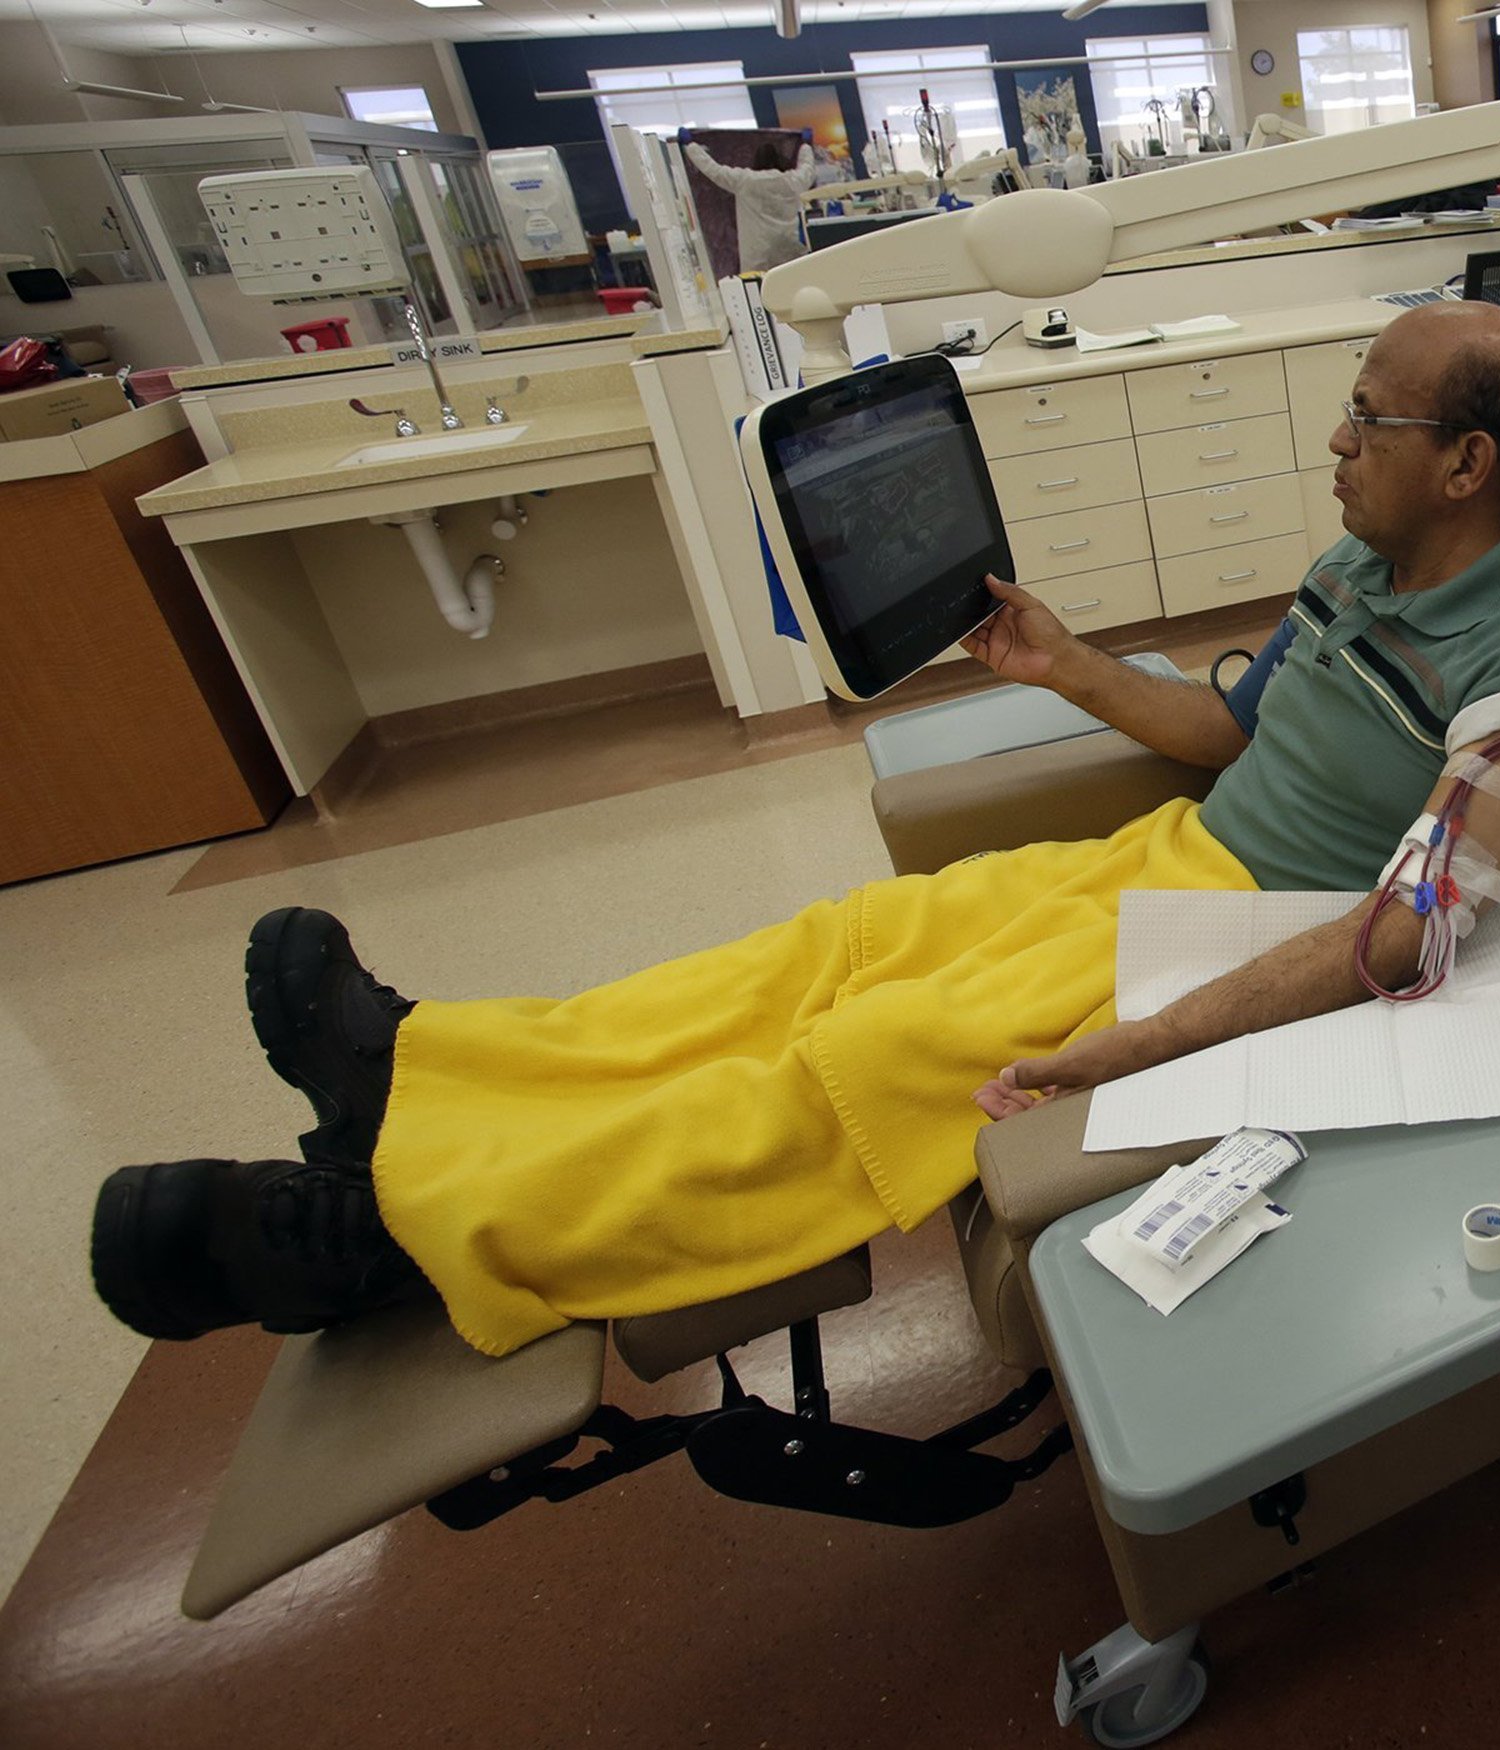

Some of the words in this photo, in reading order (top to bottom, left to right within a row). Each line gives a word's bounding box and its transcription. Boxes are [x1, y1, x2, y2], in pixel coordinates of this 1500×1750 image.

[397, 347, 437, 362] DIRY
[441, 343, 474, 357] SINK
[760, 329, 780, 380] GRIEVANCE
